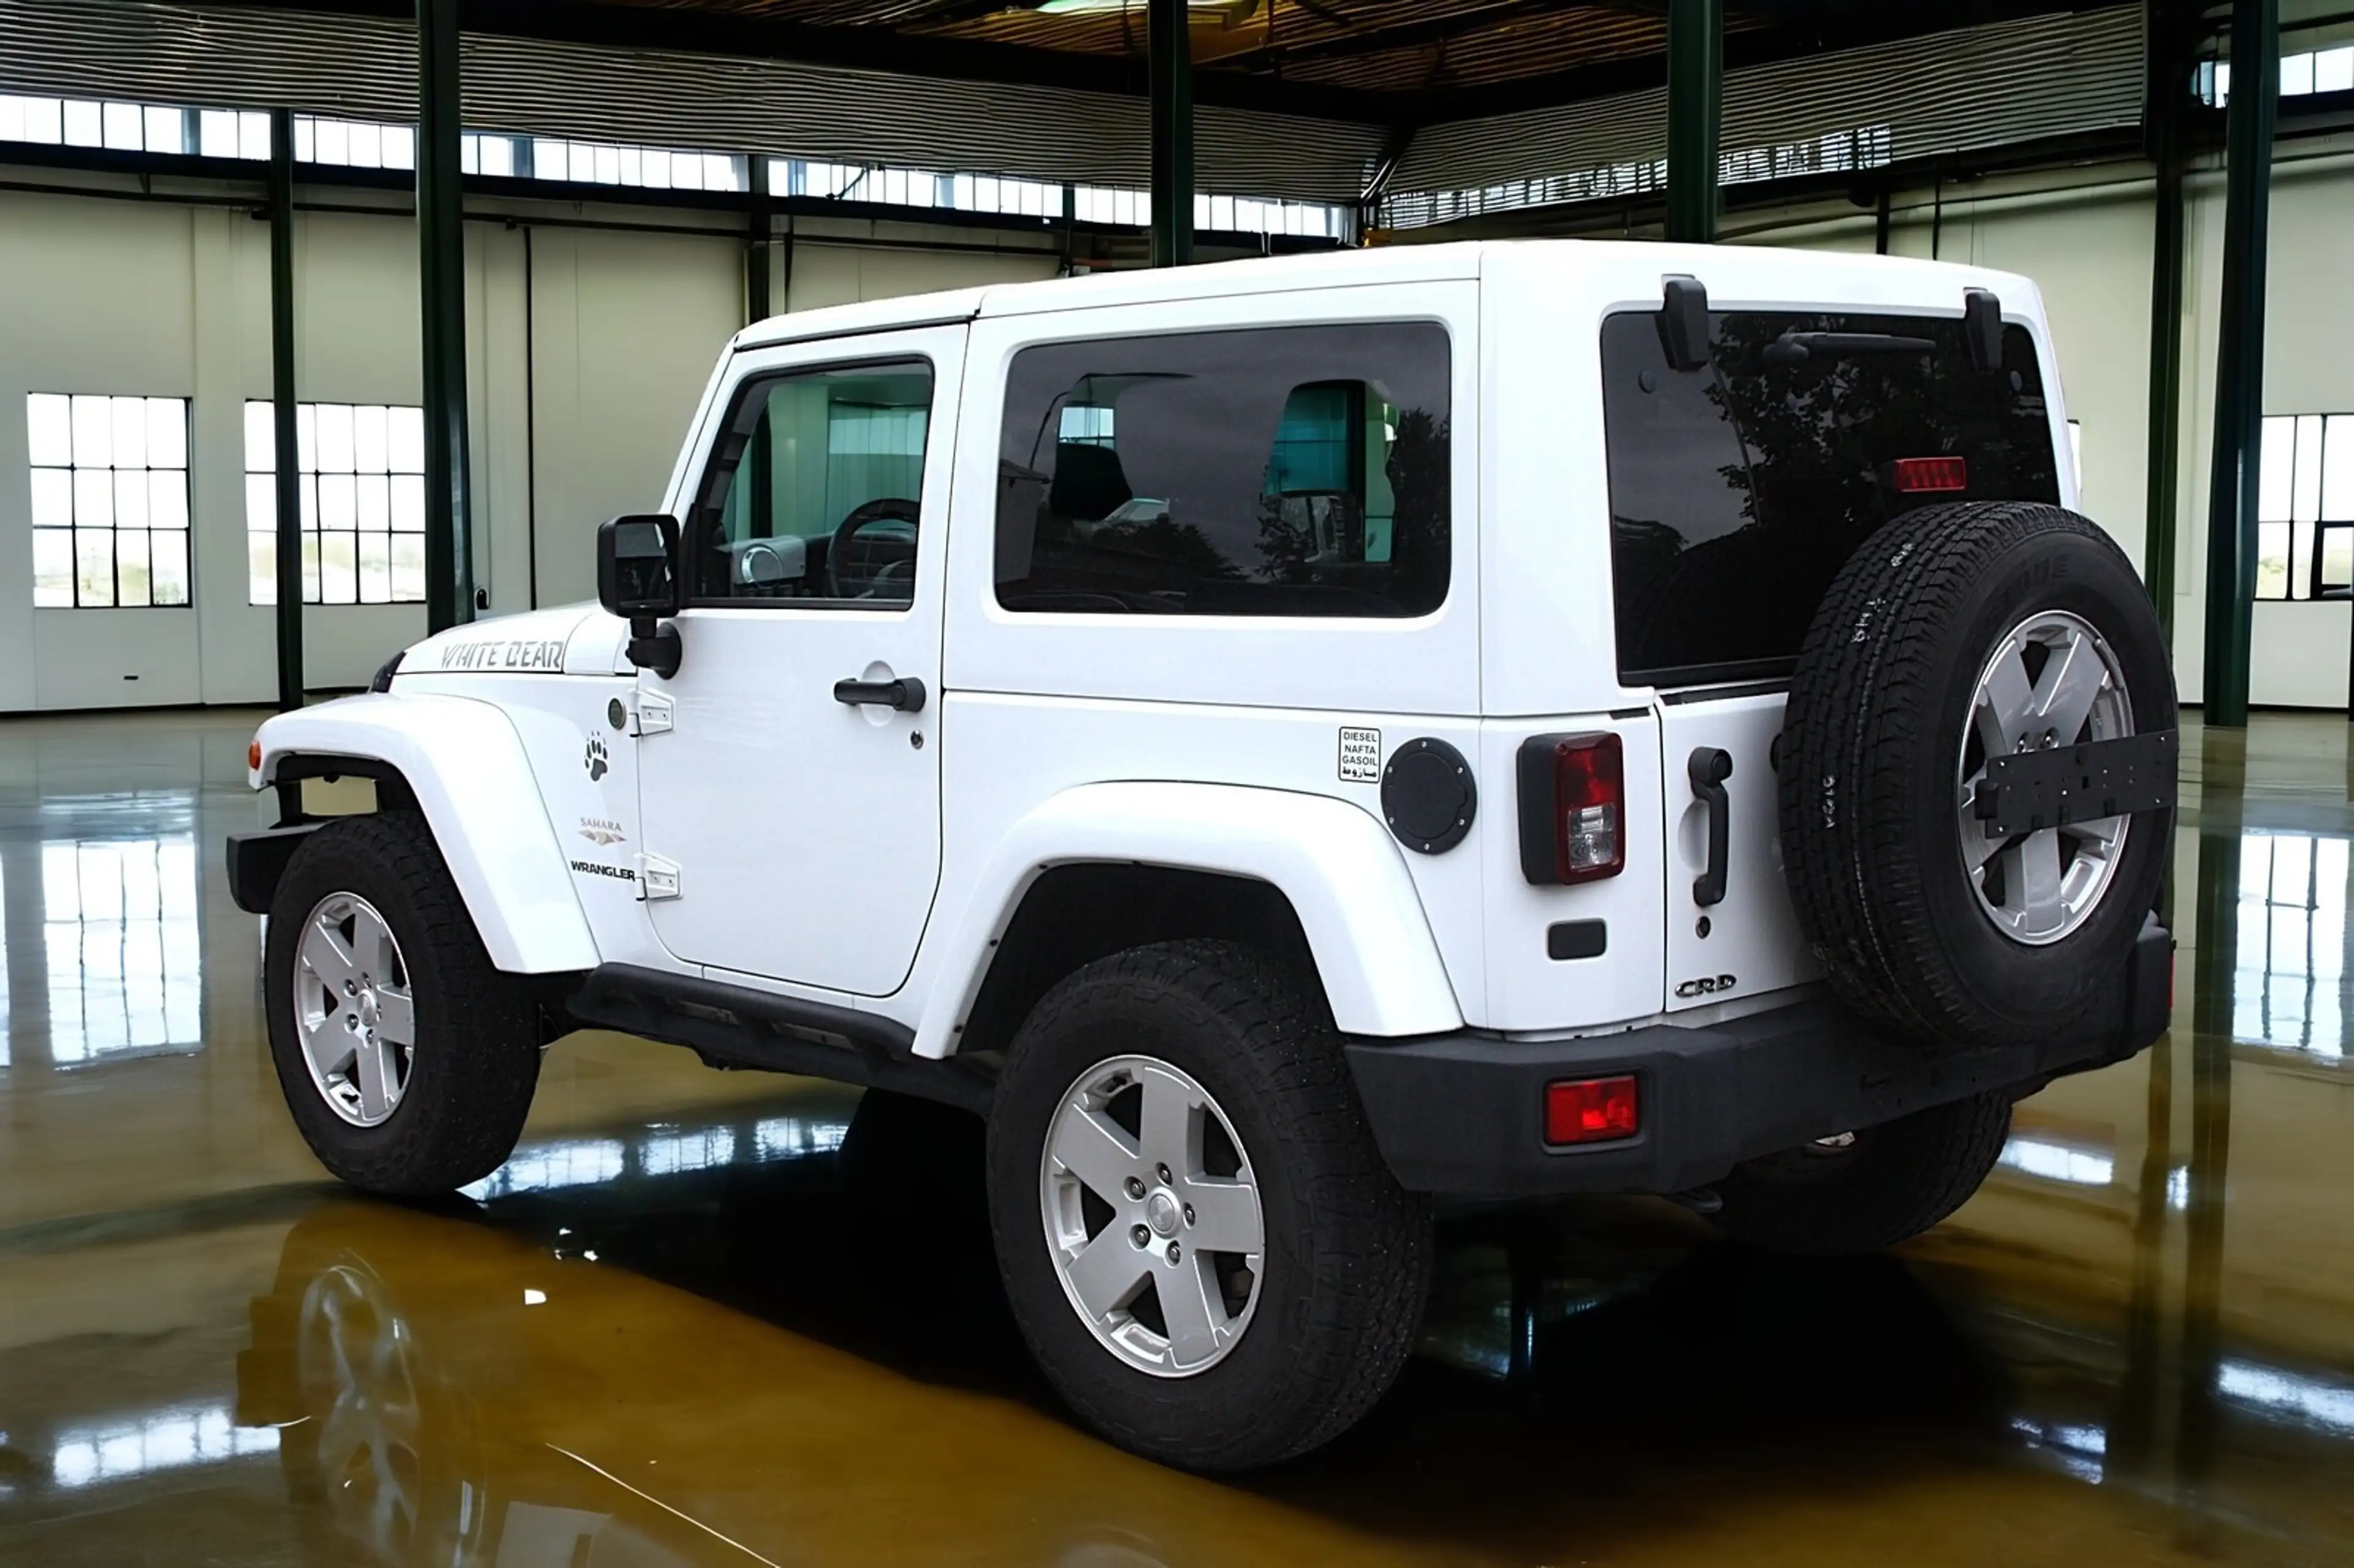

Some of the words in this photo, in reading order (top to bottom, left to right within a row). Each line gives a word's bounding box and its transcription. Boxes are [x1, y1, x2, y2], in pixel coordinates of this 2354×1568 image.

[441, 642, 506, 669] WHITE
[505, 641, 565, 668] BEAR
[1343, 731, 1377, 742] DIESEL
[1345, 745, 1376, 755] NAFTA
[1342, 755, 1377, 766] GASOIL
[581, 818, 622, 832] SAHARA
[571, 861, 636, 881] WRANGLER
[1675, 974, 1737, 999] CRD
